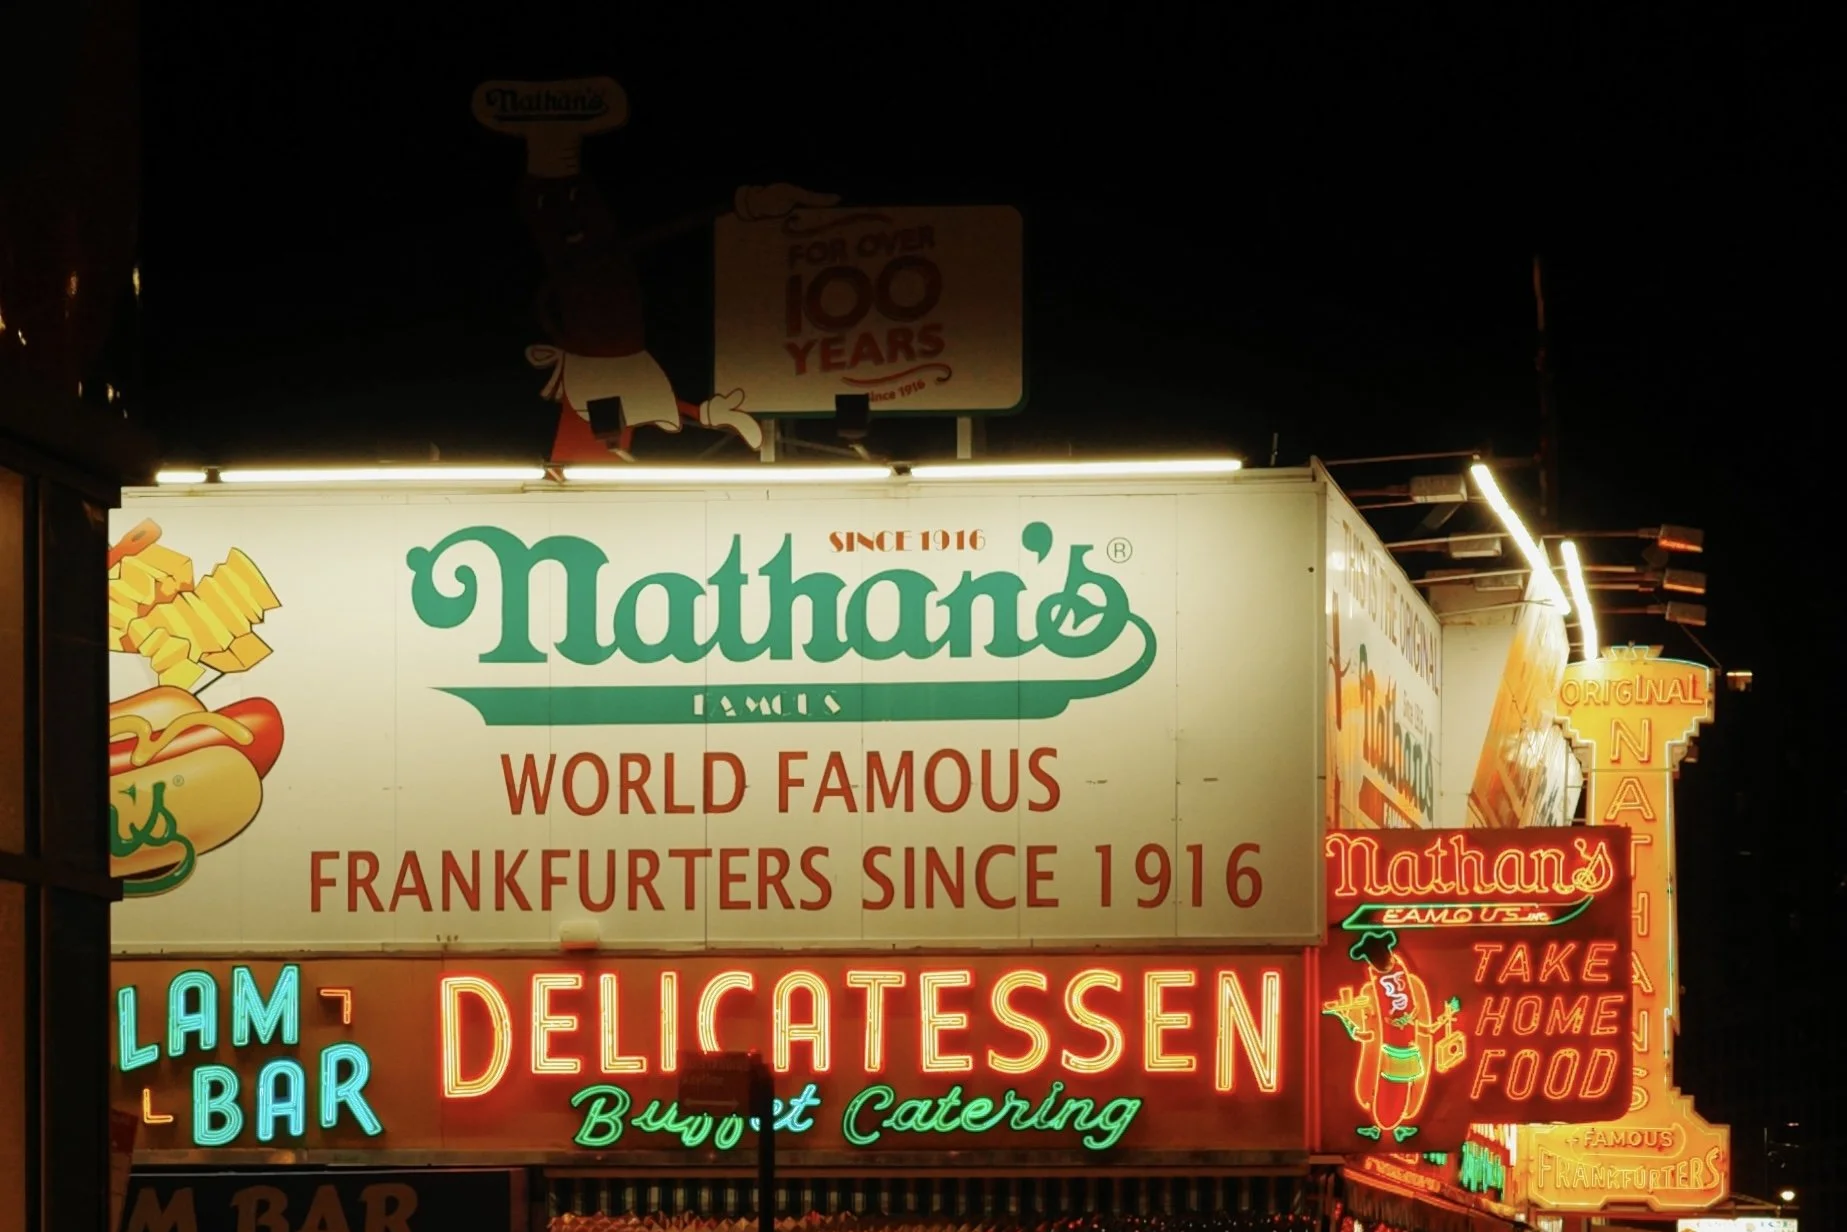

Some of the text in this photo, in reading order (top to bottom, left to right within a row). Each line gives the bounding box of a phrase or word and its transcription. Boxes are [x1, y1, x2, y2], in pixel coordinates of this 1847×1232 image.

[788, 225, 936, 270] FOR OVER
[785, 254, 943, 338] 100
[784, 323, 946, 376] YEARS
[898, 379, 926, 396] 1916
[828, 529, 986, 553] SINCE 1916
[406, 522, 1156, 667] Nathan's
[1398, 593, 1439, 697] ORIGINAL
[1560, 674, 1705, 707] ORIGINAL
[500, 747, 1061, 816] WORLD FAMOUS
[309, 842, 1263, 913] FRANKFURTERS SINCE 1916
[1325, 833, 1613, 896] Nathan's
[1473, 943, 1618, 984] TAKE
[440, 968, 1283, 1098] DELICATESSEN
[1475, 994, 1625, 1037] HOME
[192, 1042, 383, 1147] BAR
[1470, 1047, 1619, 1101] FOOD
[841, 1080, 1142, 1151] Catering
[1584, 1130, 1674, 1148] FAMOUS
[1537, 1145, 1721, 1190] FRANKFURTERS
